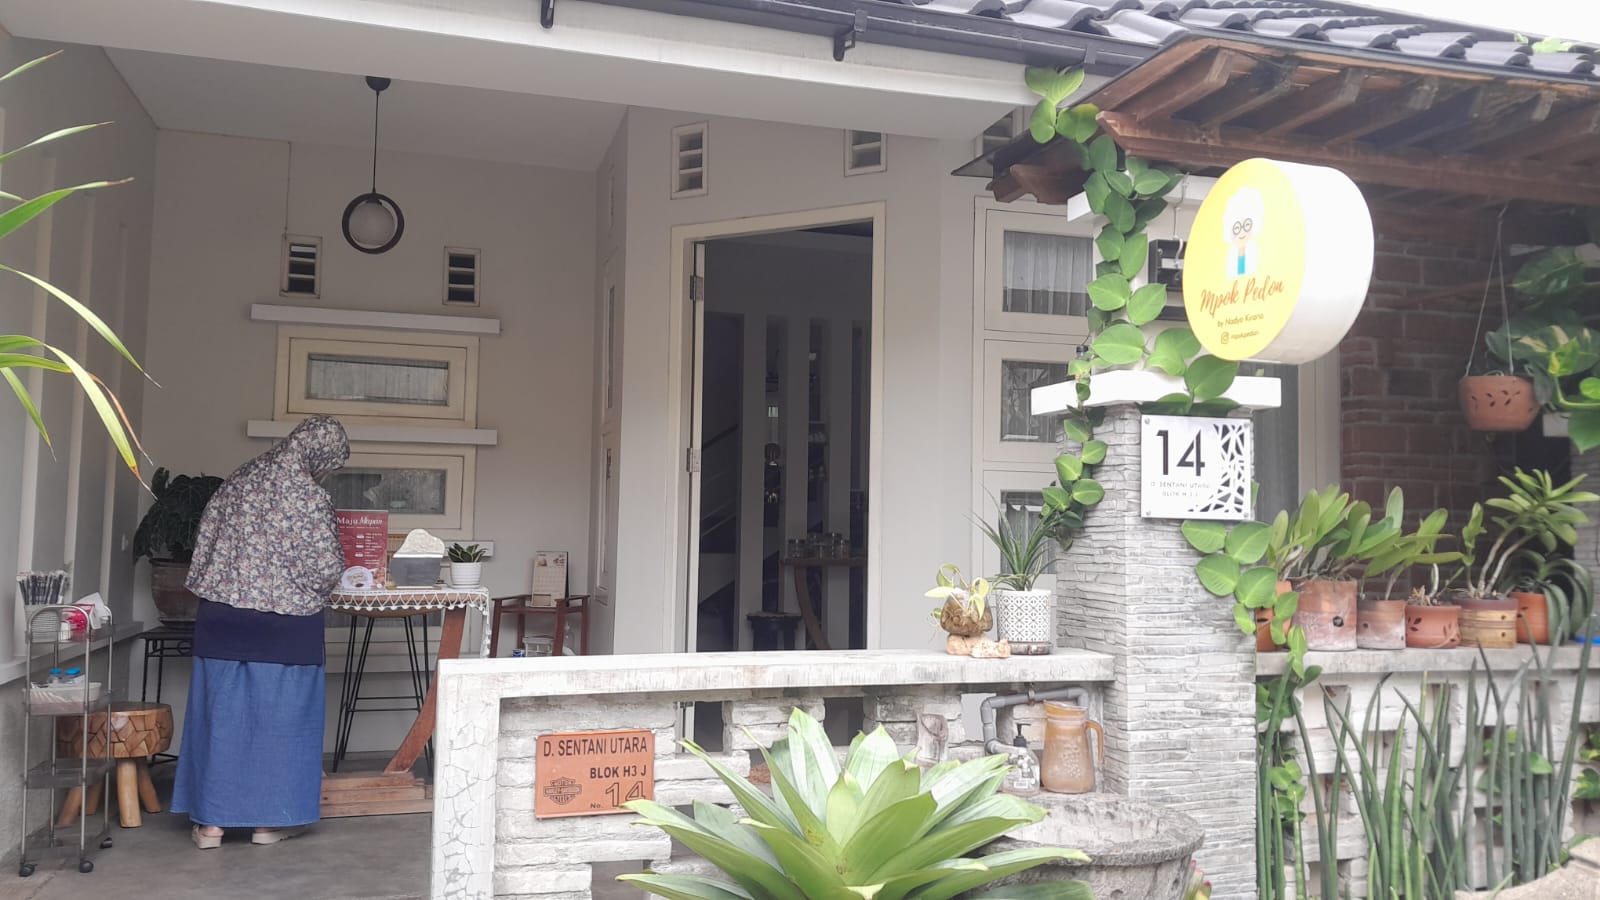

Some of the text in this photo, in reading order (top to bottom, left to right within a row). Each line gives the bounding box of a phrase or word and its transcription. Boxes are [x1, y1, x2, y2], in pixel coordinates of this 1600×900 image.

[1200, 280, 1240, 318] Mpok
[1156, 429, 1205, 476] 14
[336, 516, 357, 525] Maju
[543, 736, 647, 757] D. SENTANI UTARA
[590, 764, 647, 779] BLOK H3 J
[605, 780, 647, 808] 14
